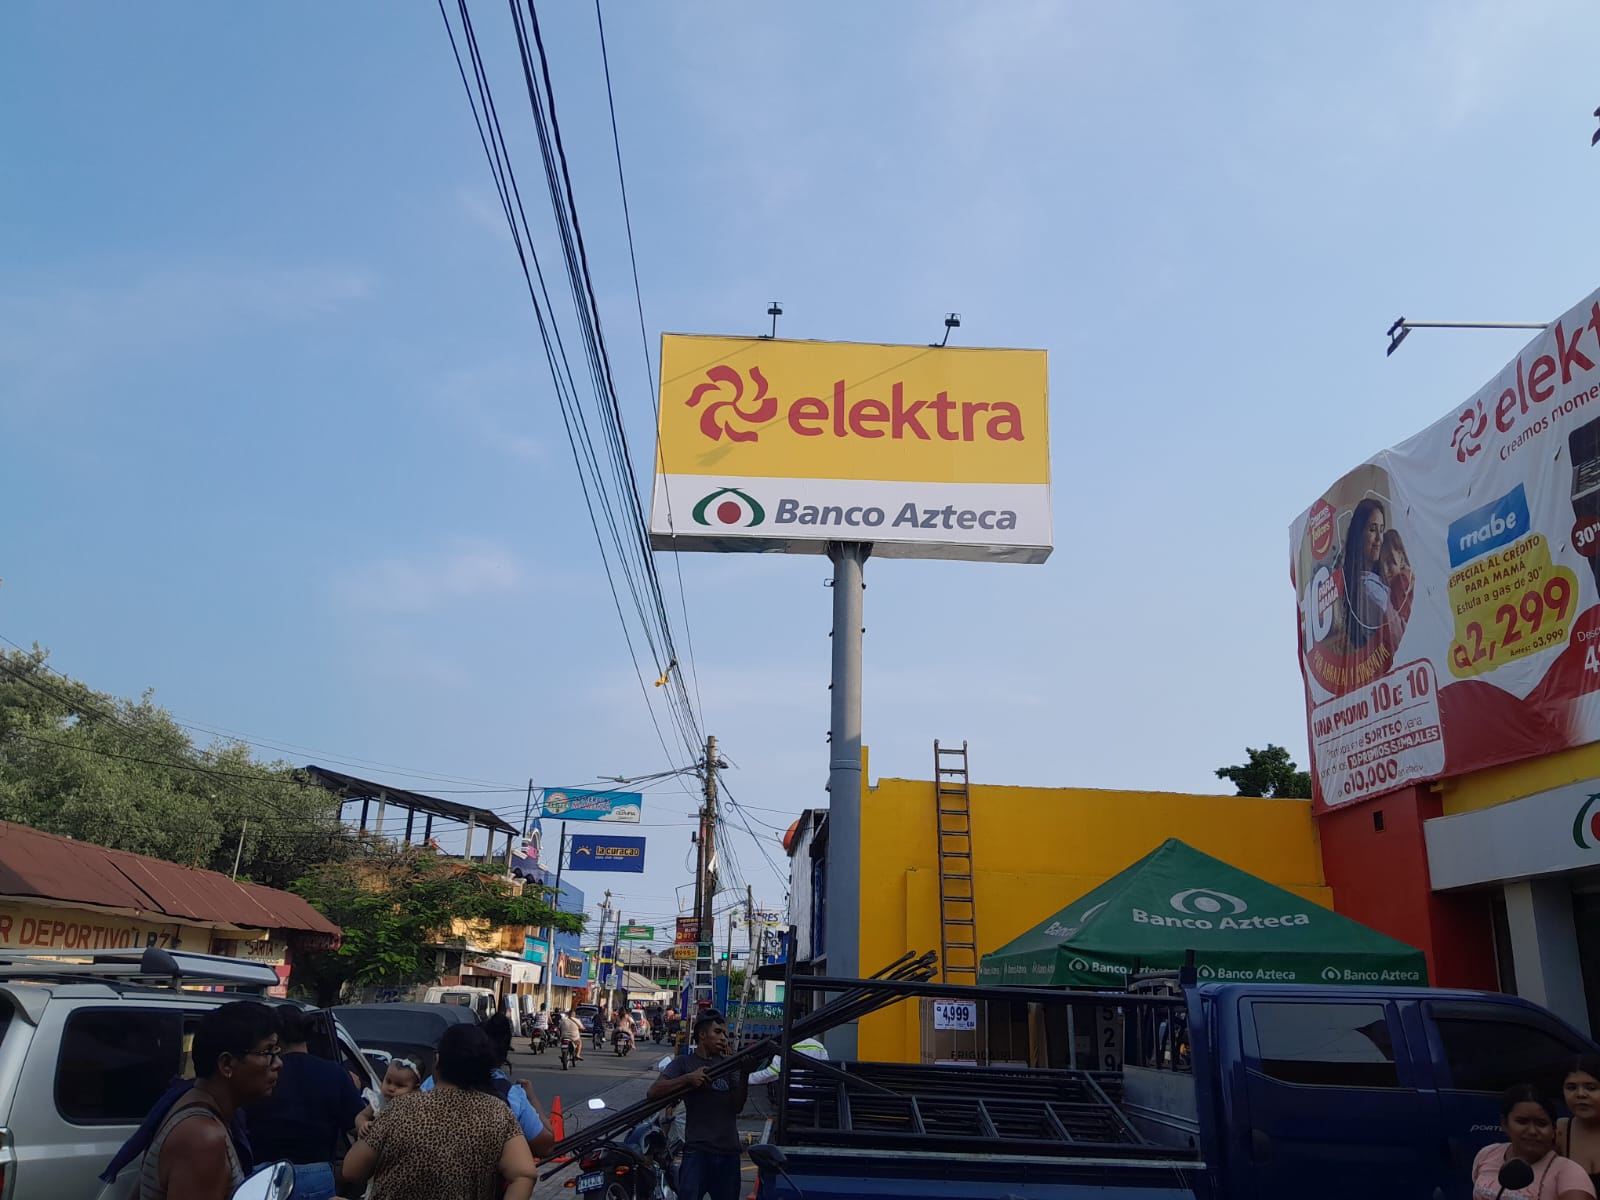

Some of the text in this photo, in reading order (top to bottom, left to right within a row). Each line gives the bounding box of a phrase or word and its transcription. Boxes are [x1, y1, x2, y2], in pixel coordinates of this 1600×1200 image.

[787, 379, 1025, 442] elektra
[1500, 416, 1549, 461] Creamos
[775, 498, 1017, 531] Banco Azteca
[1459, 511, 1517, 551] mabe
[1449, 535, 1540, 588] ESPECIAL AL CRÉDITO
[1465, 557, 1526, 594] PARA MAMÁ
[1318, 576, 1335, 600] PARA
[1456, 595, 1482, 615] Estufa
[1484, 594, 1490, 602] a
[1493, 585, 1511, 600] gas
[1514, 578, 1526, 590] de
[1453, 576, 1571, 669] Q2,299
[1371, 682, 1392, 714] 10
[1407, 666, 1430, 698] 10
[1343, 759, 1398, 795] Q10,000
[1132, 908, 1310, 931] Banco Azteca
[1091, 961, 1127, 974] Banco
[1217, 966, 1296, 981] Banco Azteca
[1343, 968, 1420, 982] Banco Azteca
